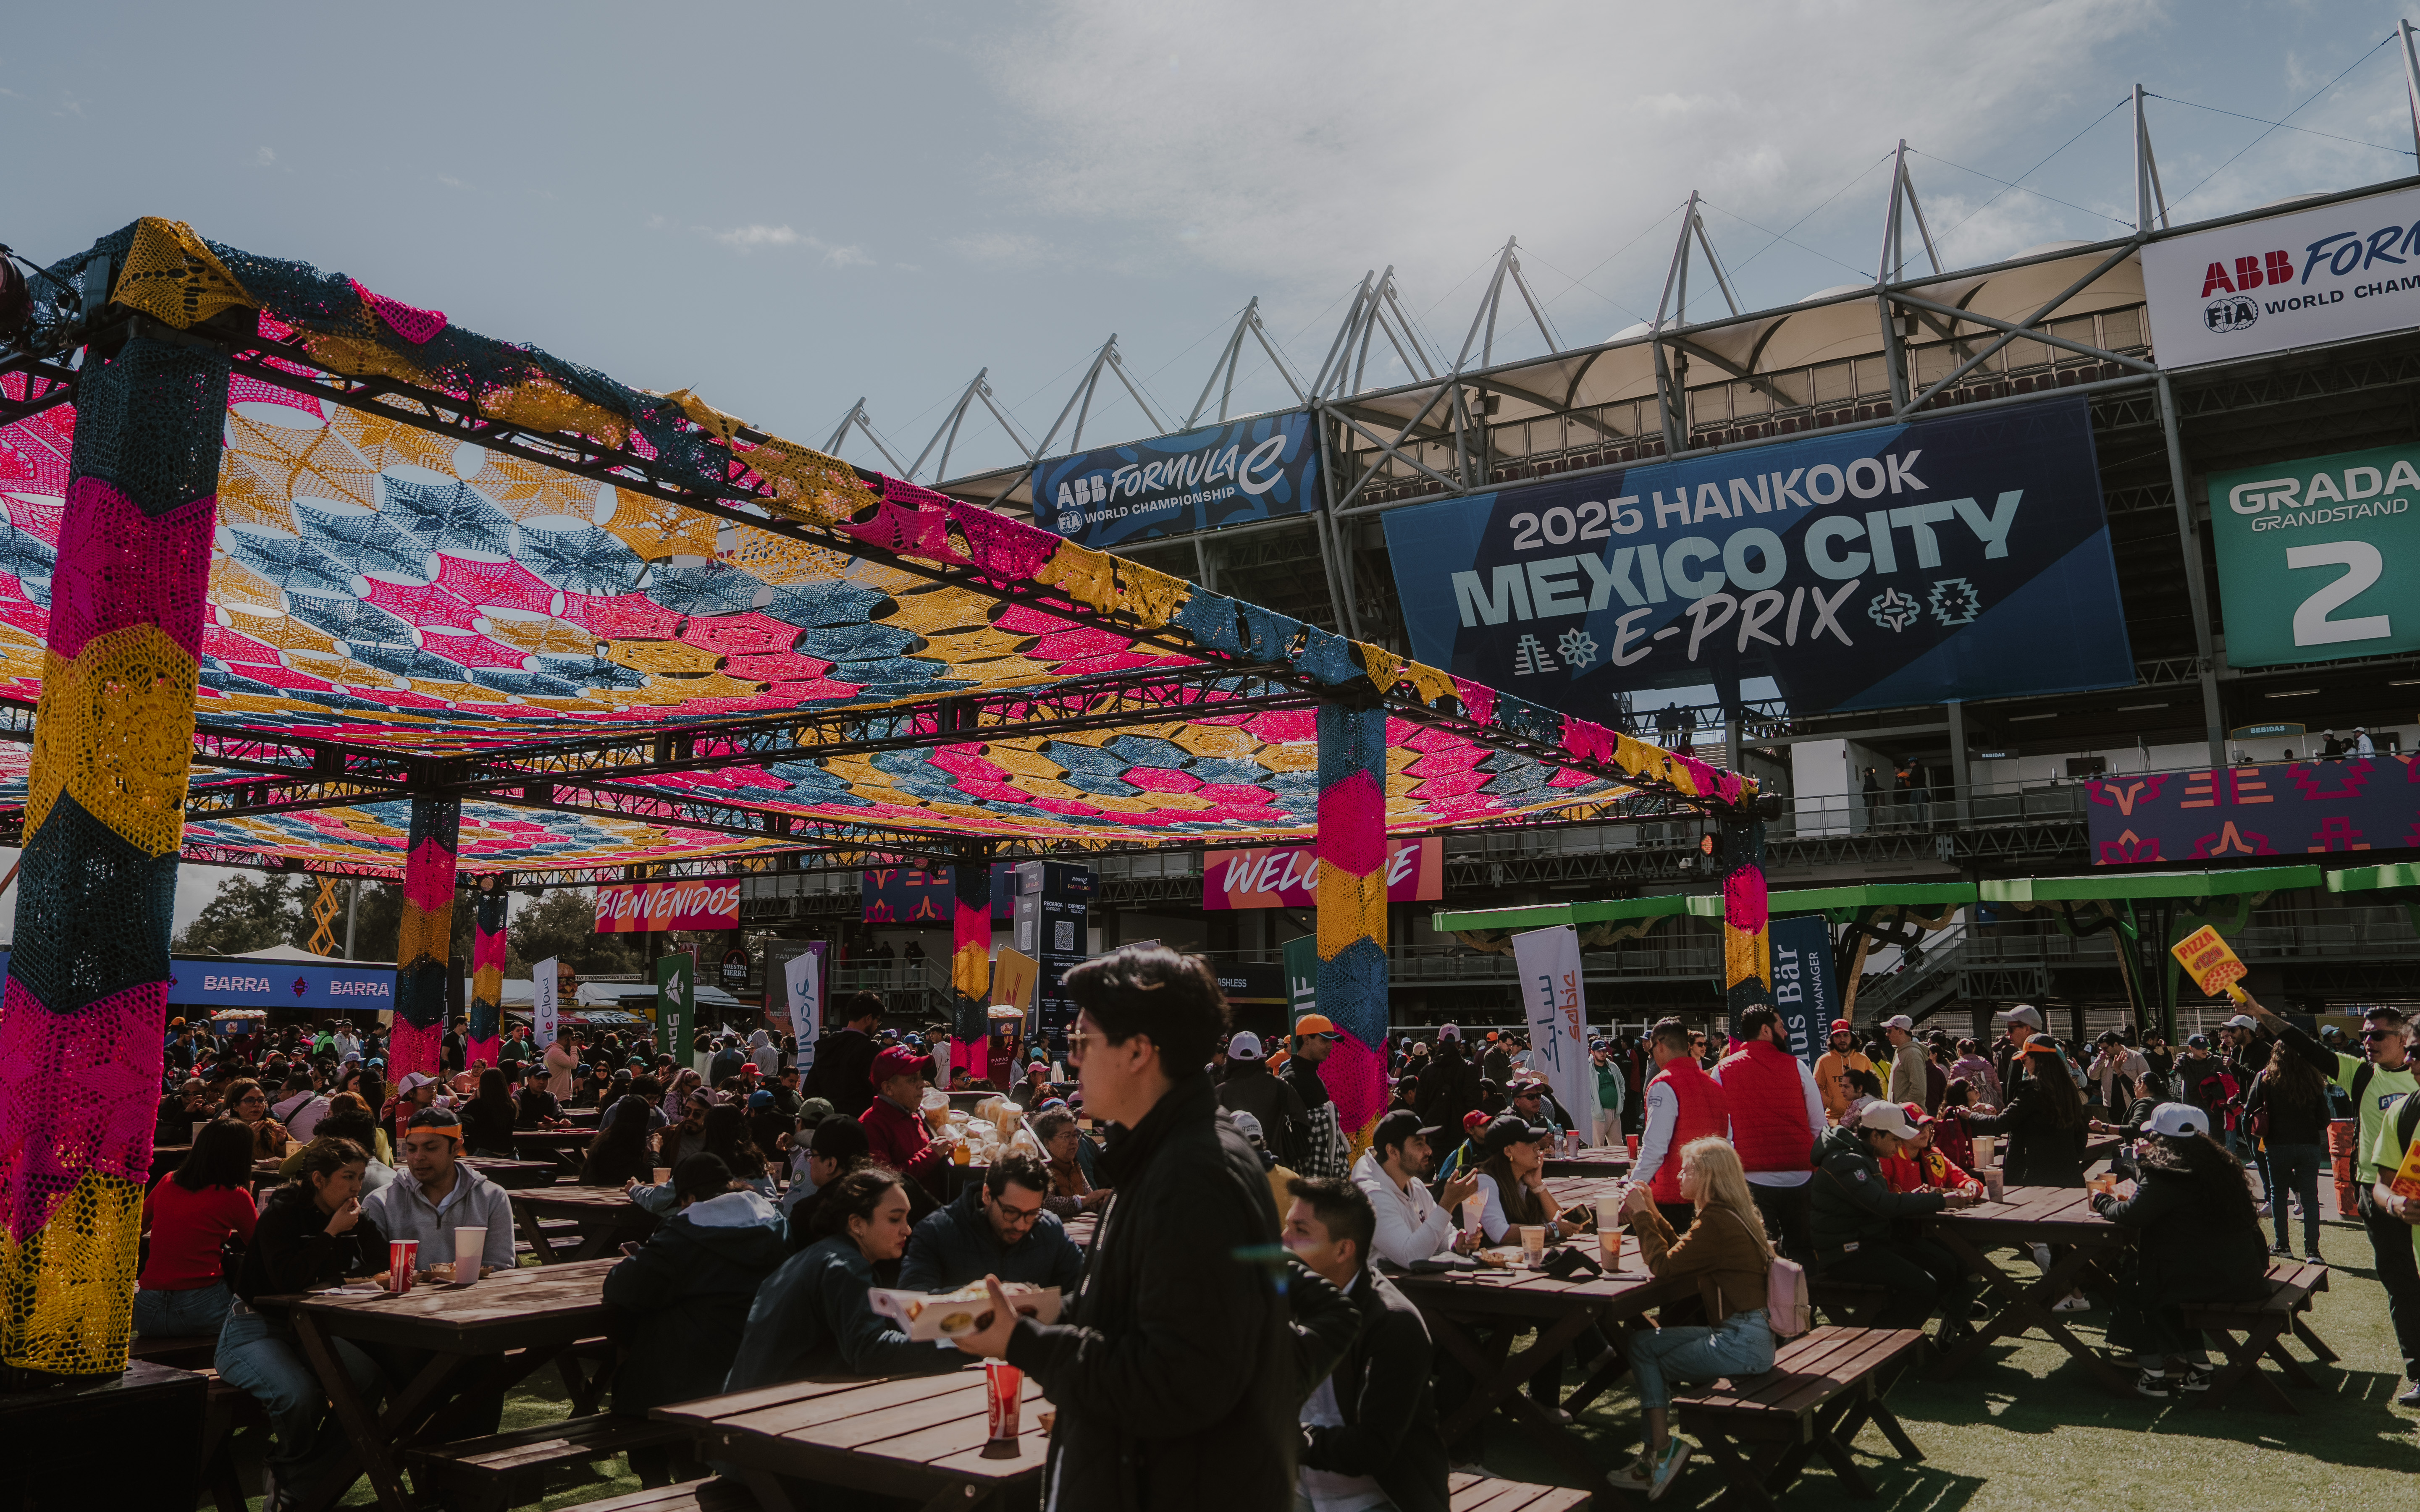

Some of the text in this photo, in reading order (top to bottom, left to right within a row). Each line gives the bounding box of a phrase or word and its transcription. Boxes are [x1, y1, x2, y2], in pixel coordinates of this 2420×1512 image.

[2201, 250, 2294, 298] ABB
[2264, 290, 2344, 314] WORLD
[1056, 475, 1107, 509] ABB
[1110, 444, 1239, 502] FORMULA
[1511, 449, 1929, 551] 2025 HANKOOK
[2229, 461, 2420, 514] GRADA
[1084, 506, 1128, 524] WORLD
[1132, 487, 1235, 515] CHAMPIONSHIP
[2252, 499, 2408, 532] GRANDSTAND
[1451, 489, 2024, 628] MEXICO CITY
[2286, 541, 2391, 647] 2
[1612, 579, 1861, 667] E-PRIX
[595, 885, 740, 920] BIENVENIDOS
[2178, 931, 2215, 960] PIZZA
[2193, 946, 2224, 971] $120
[203, 976, 390, 997] BARRA BARRA
[541, 977, 552, 1018] Cloud
[1217, 978, 1247, 988] ASHLESS
[1774, 944, 1803, 1005] Bär
[1808, 951, 1825, 1010] MANAGER
[1559, 970, 1581, 1043] sabic
